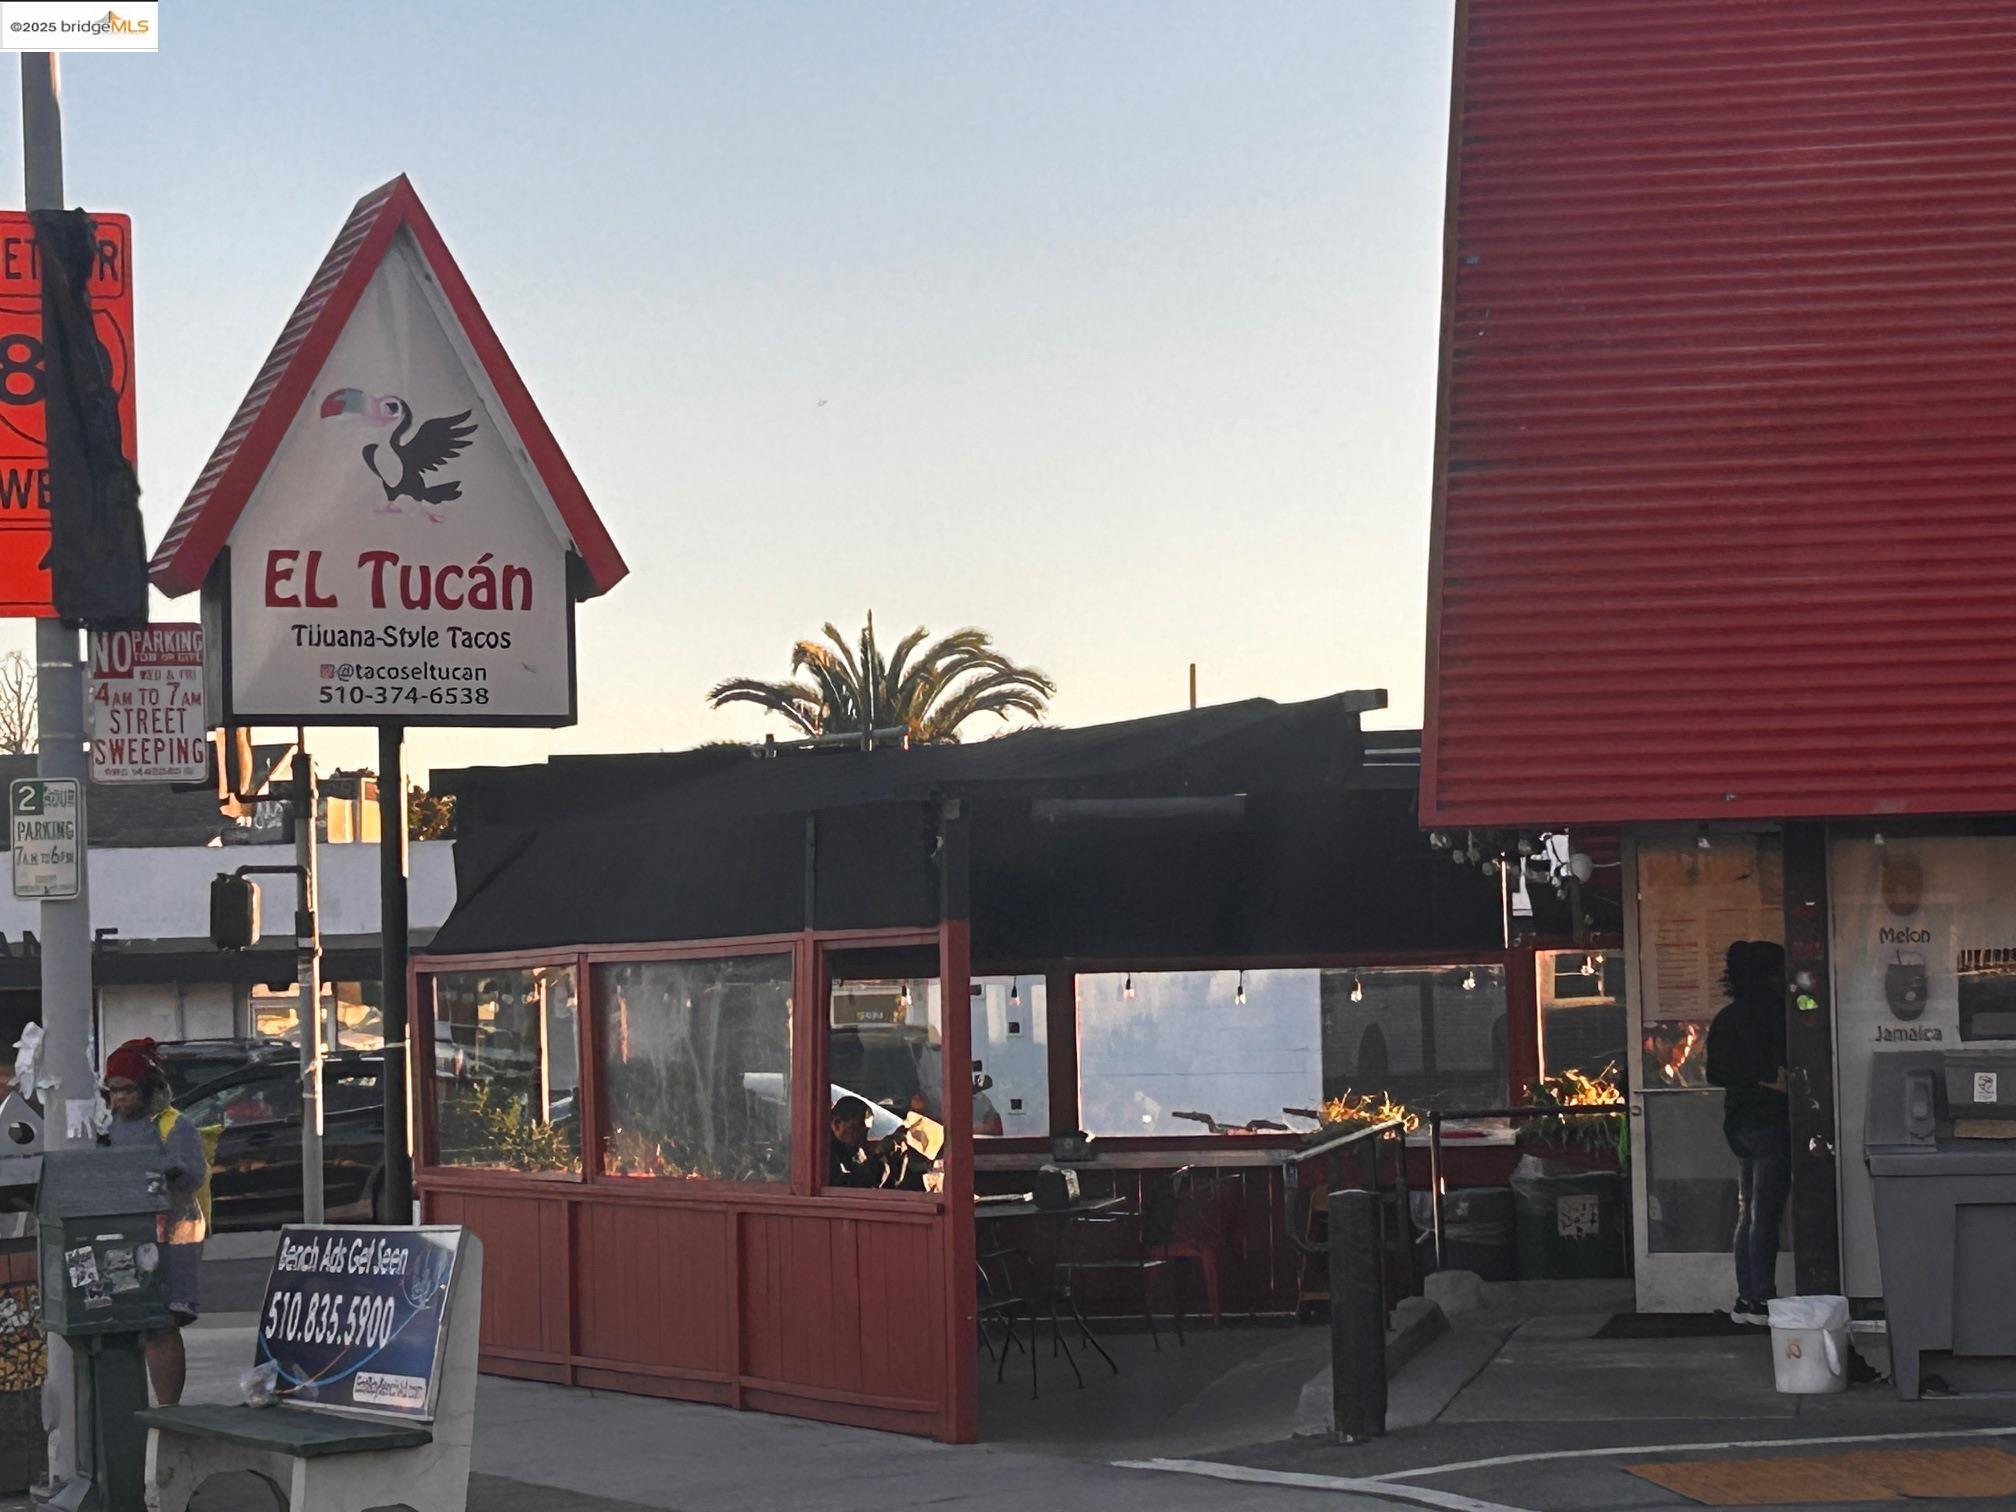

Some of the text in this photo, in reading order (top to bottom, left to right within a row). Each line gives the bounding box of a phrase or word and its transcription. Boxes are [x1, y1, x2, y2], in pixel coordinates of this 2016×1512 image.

[265, 550, 533, 611] EL Tucán
[291, 624, 511, 649] Tijuana-Style Tacos
[91, 631, 203, 673] NO PARKING
[337, 661, 487, 682] @tacoseltucan
[138, 688, 159, 706] TO
[319, 686, 489, 705] 510-374-6538
[110, 708, 187, 734] STREET
[95, 738, 204, 765] SWEEPING
[18, 785, 36, 811] 2
[17, 821, 74, 841] PARKING
[1879, 927, 1931, 944] Melon
[1875, 1026, 1943, 1042] Jamaica
[319, 1237, 348, 1273] Ads
[347, 1238, 376, 1274] Get
[373, 1238, 409, 1275] Seen
[265, 1291, 395, 1349] 510.835.5900
